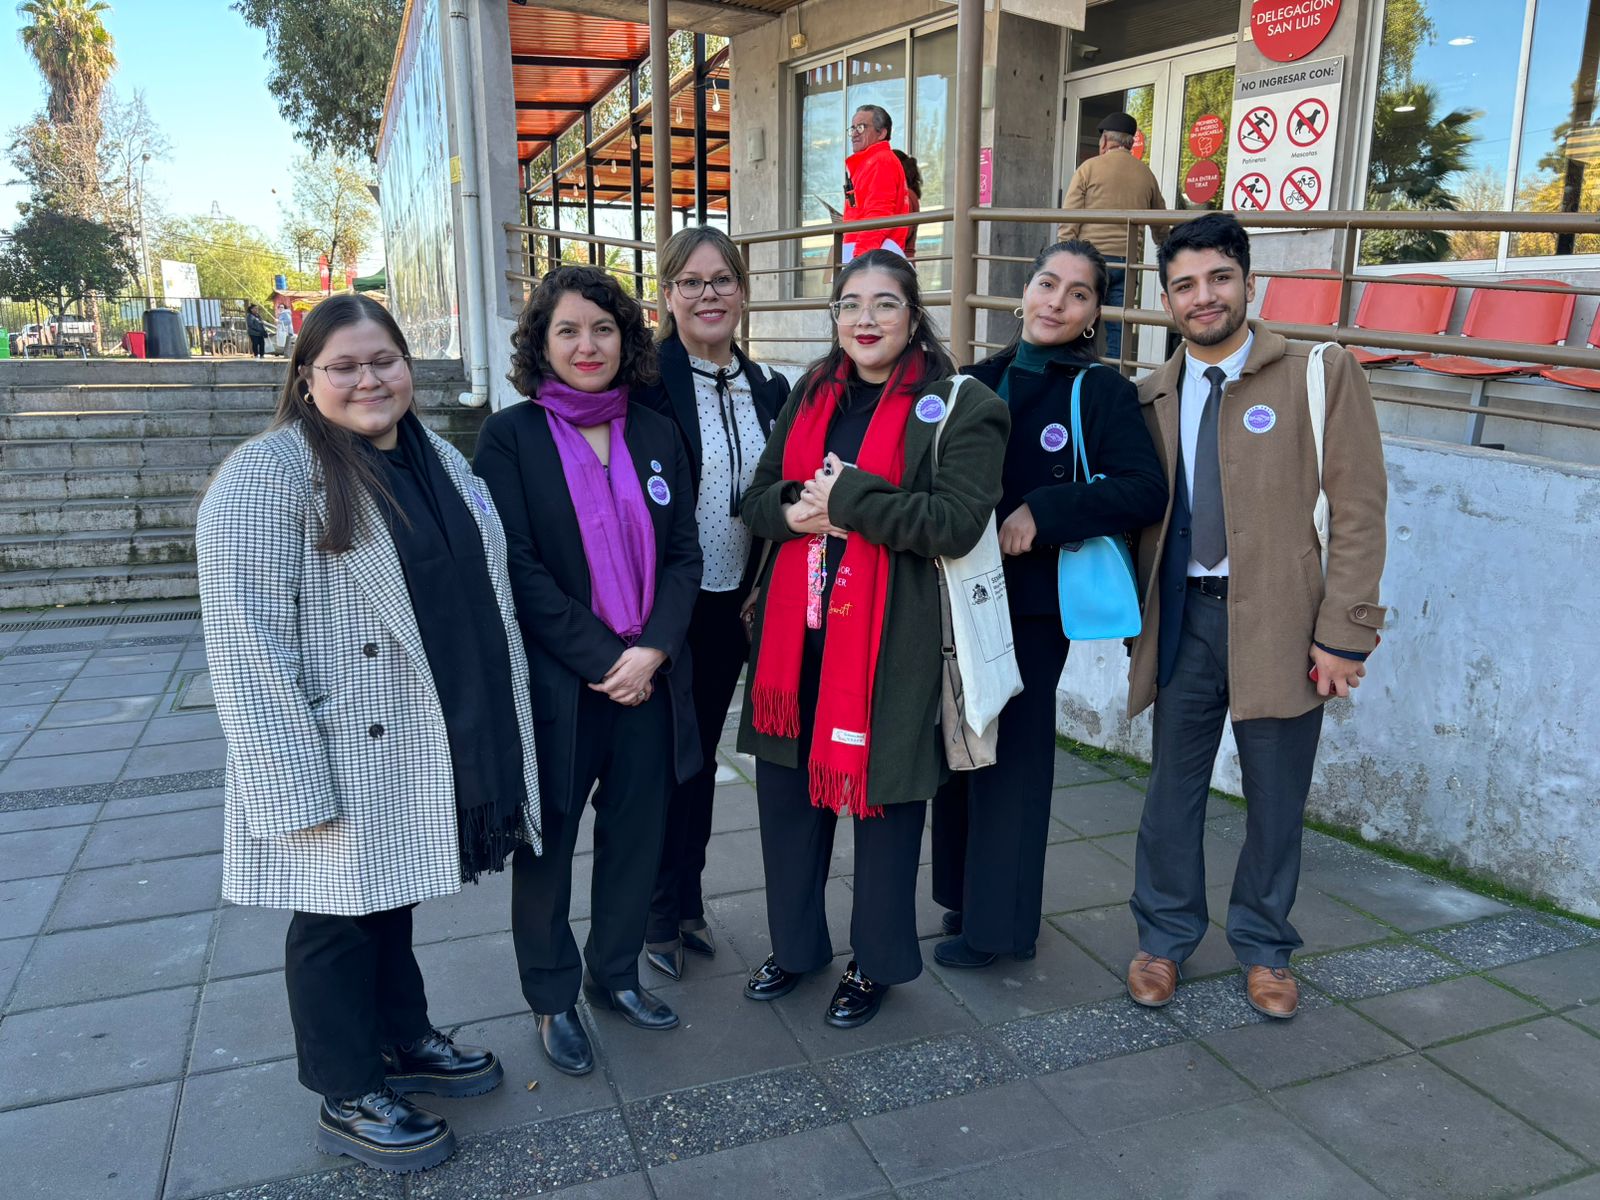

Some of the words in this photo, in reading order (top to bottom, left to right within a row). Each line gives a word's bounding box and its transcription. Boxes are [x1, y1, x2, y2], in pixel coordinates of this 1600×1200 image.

[1267, 20, 1292, 36] SAN
[1296, 13, 1320, 30] LUIS
[1241, 81, 1256, 91] NO
[1259, 72, 1306, 88] INGRESAR
[1309, 67, 1334, 80] CON:
[1290, 150, 1318, 158] Mascotas
